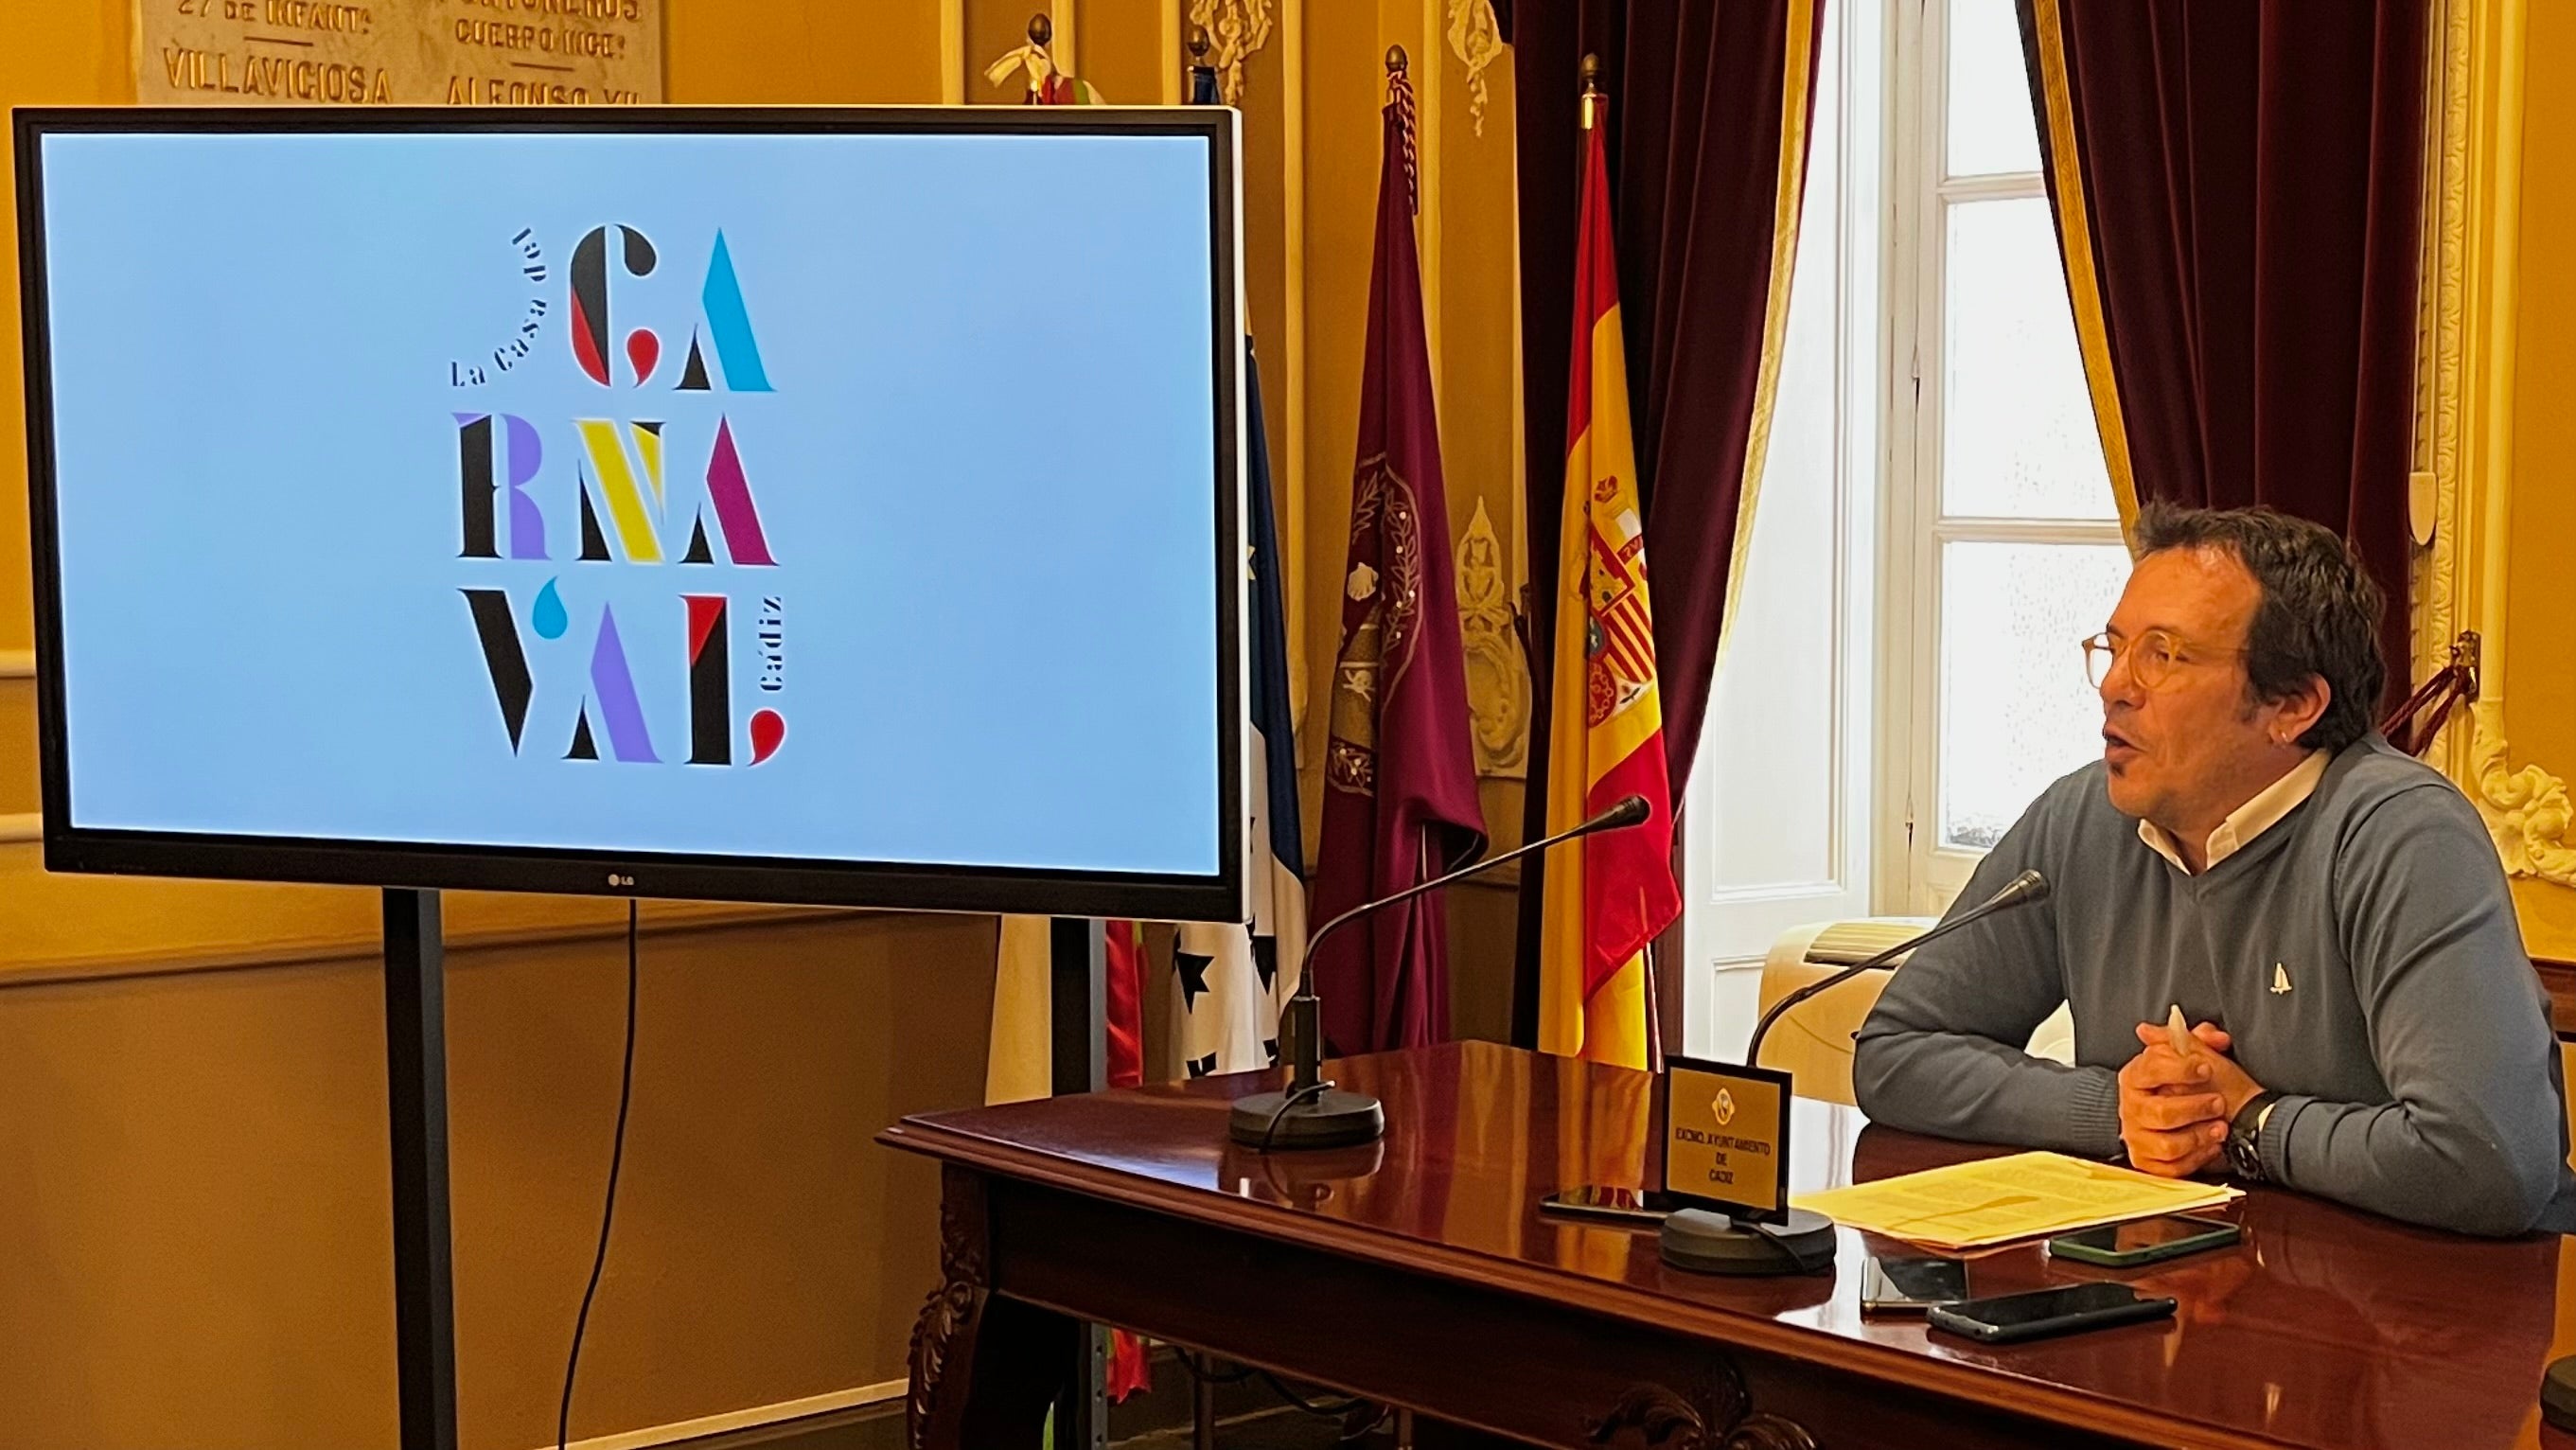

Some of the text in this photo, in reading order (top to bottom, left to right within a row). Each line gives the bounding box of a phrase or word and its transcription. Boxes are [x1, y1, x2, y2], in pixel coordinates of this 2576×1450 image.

[224, 1, 256, 21] DE
[455, 18, 555, 51] CUERPO
[164, 47, 395, 104] VILLAVICIOSA
[450, 227, 547, 387] La Casa del
[1707, 1133, 1771, 1156] AYUNTAMIENTO
[1716, 1152, 1727, 1166] DE
